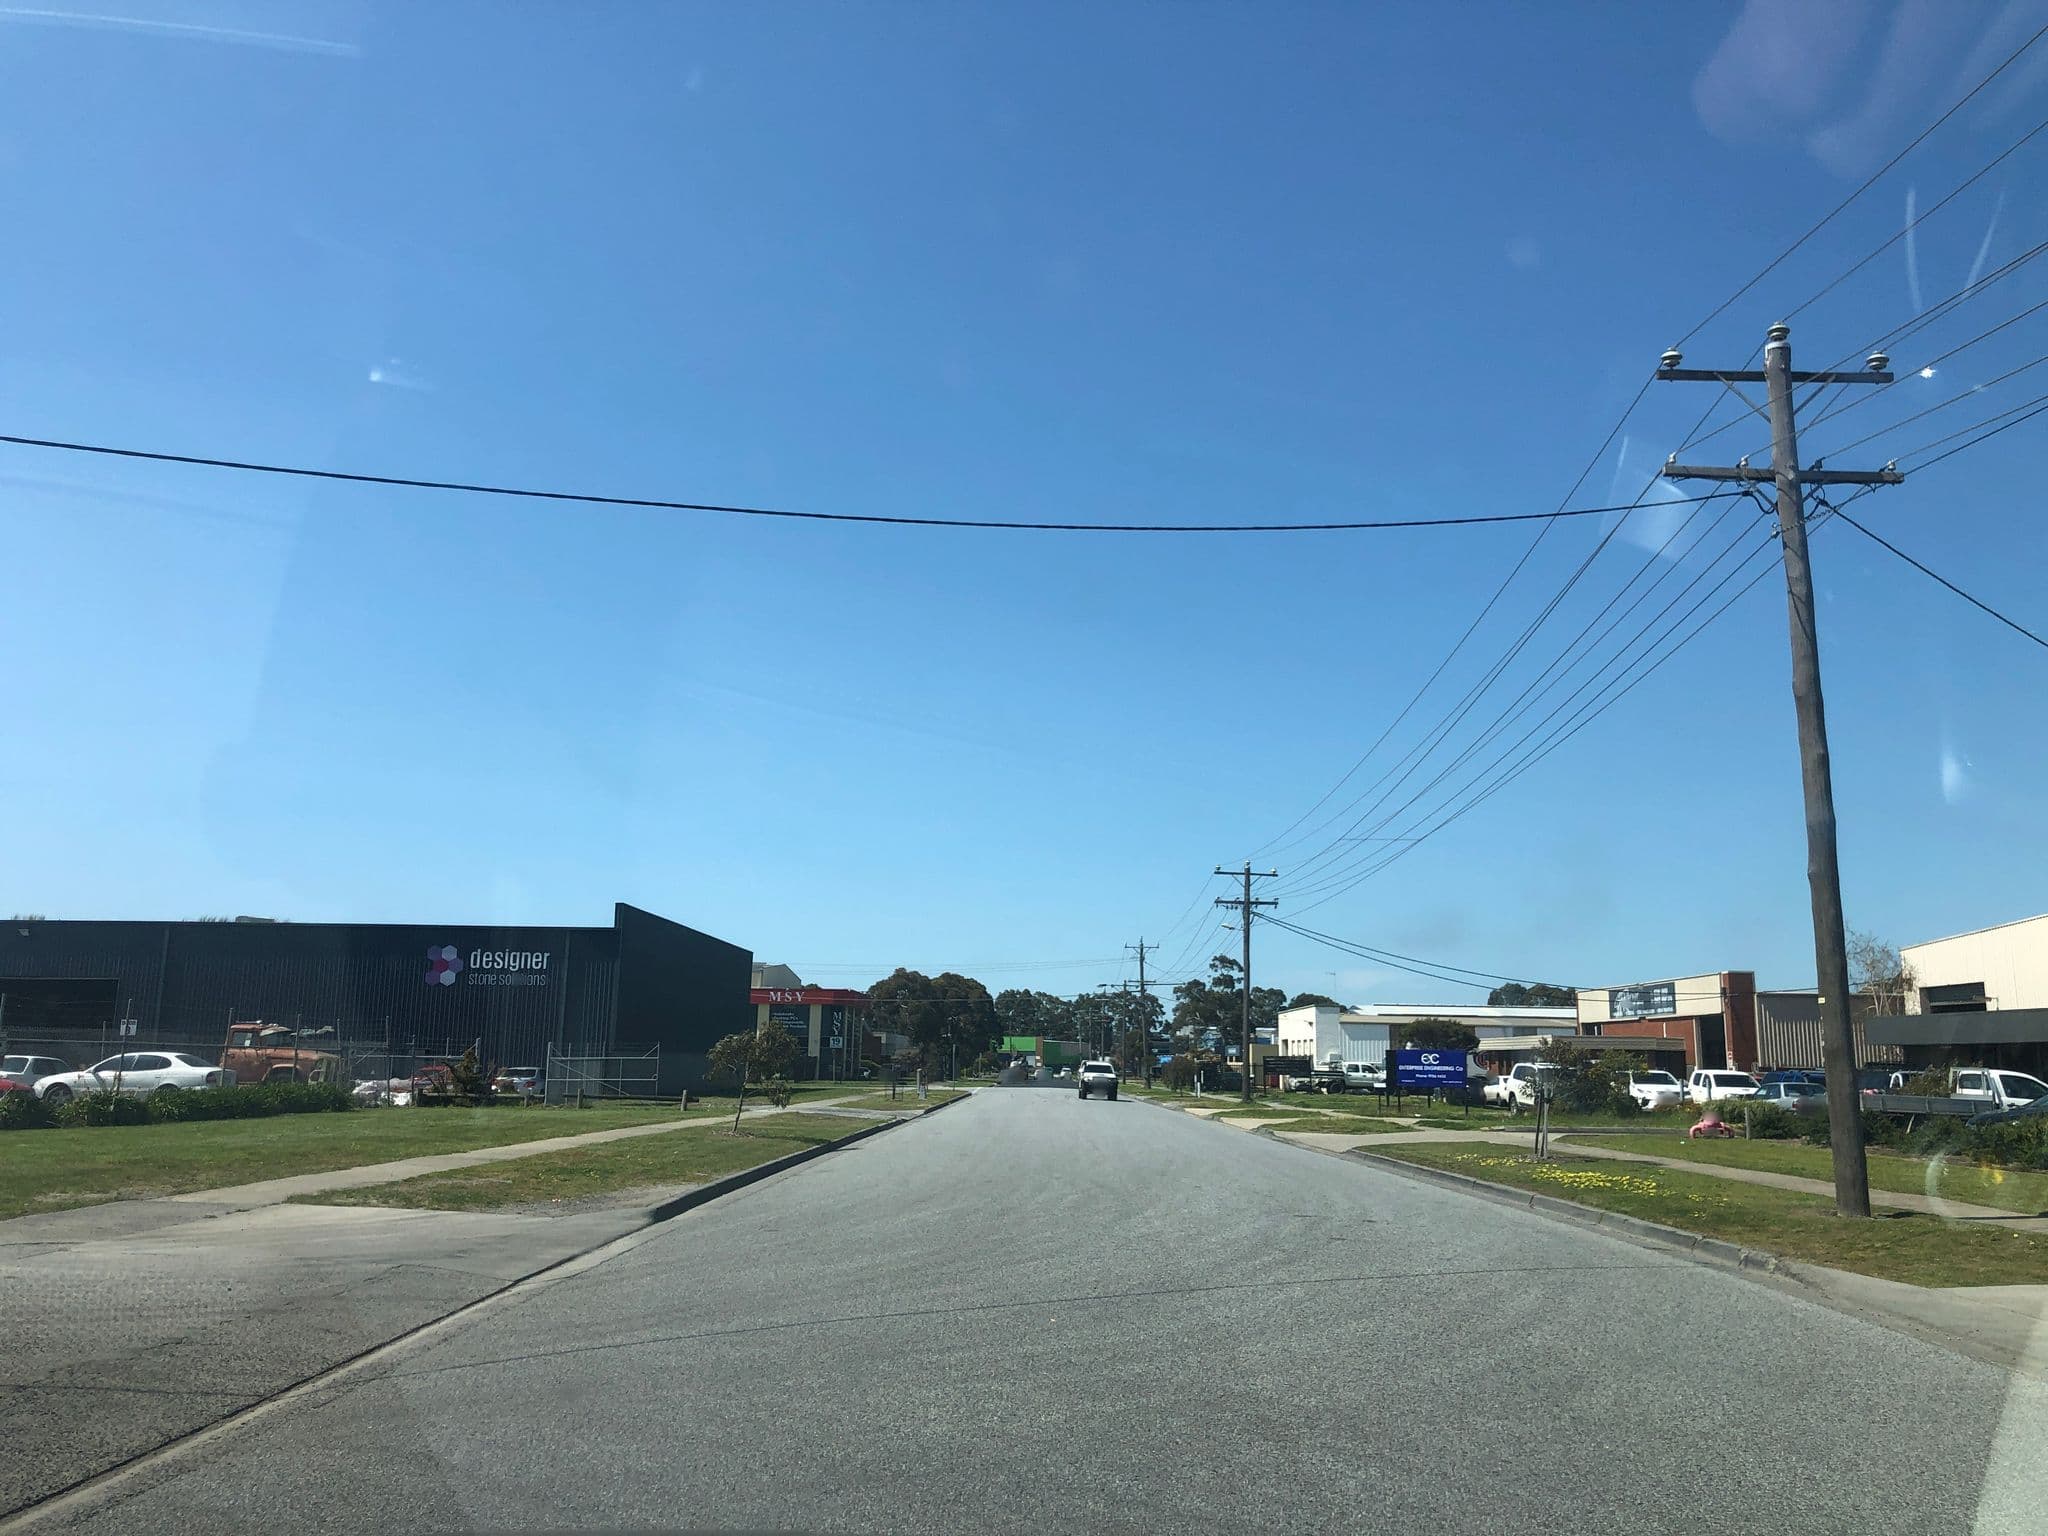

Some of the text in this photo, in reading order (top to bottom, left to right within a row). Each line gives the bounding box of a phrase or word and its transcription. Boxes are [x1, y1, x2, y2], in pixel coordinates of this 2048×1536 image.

[470, 949, 550, 971] designer
[468, 973, 546, 986] stone soions
